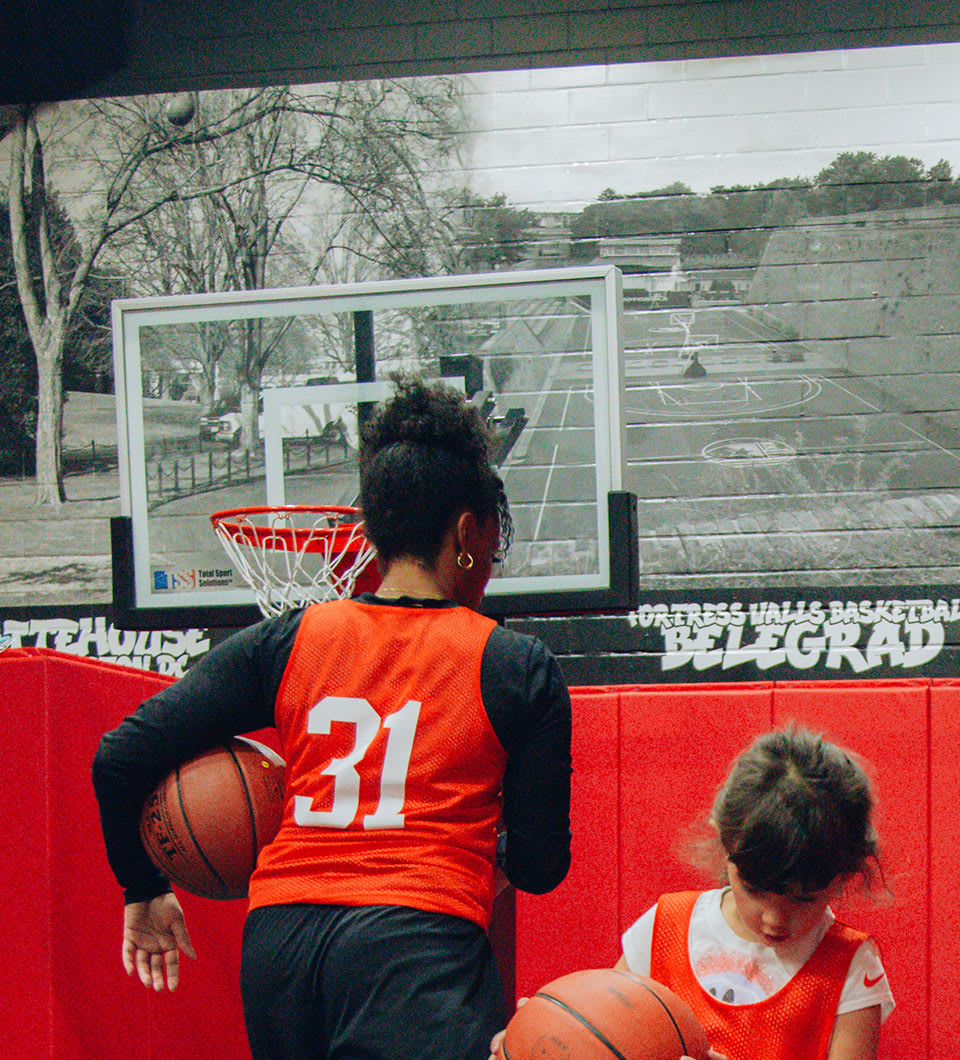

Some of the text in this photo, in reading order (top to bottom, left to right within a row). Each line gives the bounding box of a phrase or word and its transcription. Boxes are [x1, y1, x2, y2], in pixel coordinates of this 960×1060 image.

[215, 569, 233, 577] Sport
[750, 601, 829, 625] WALLS
[661, 620, 945, 673] BELEGRAD
[294, 696, 422, 831] 31
